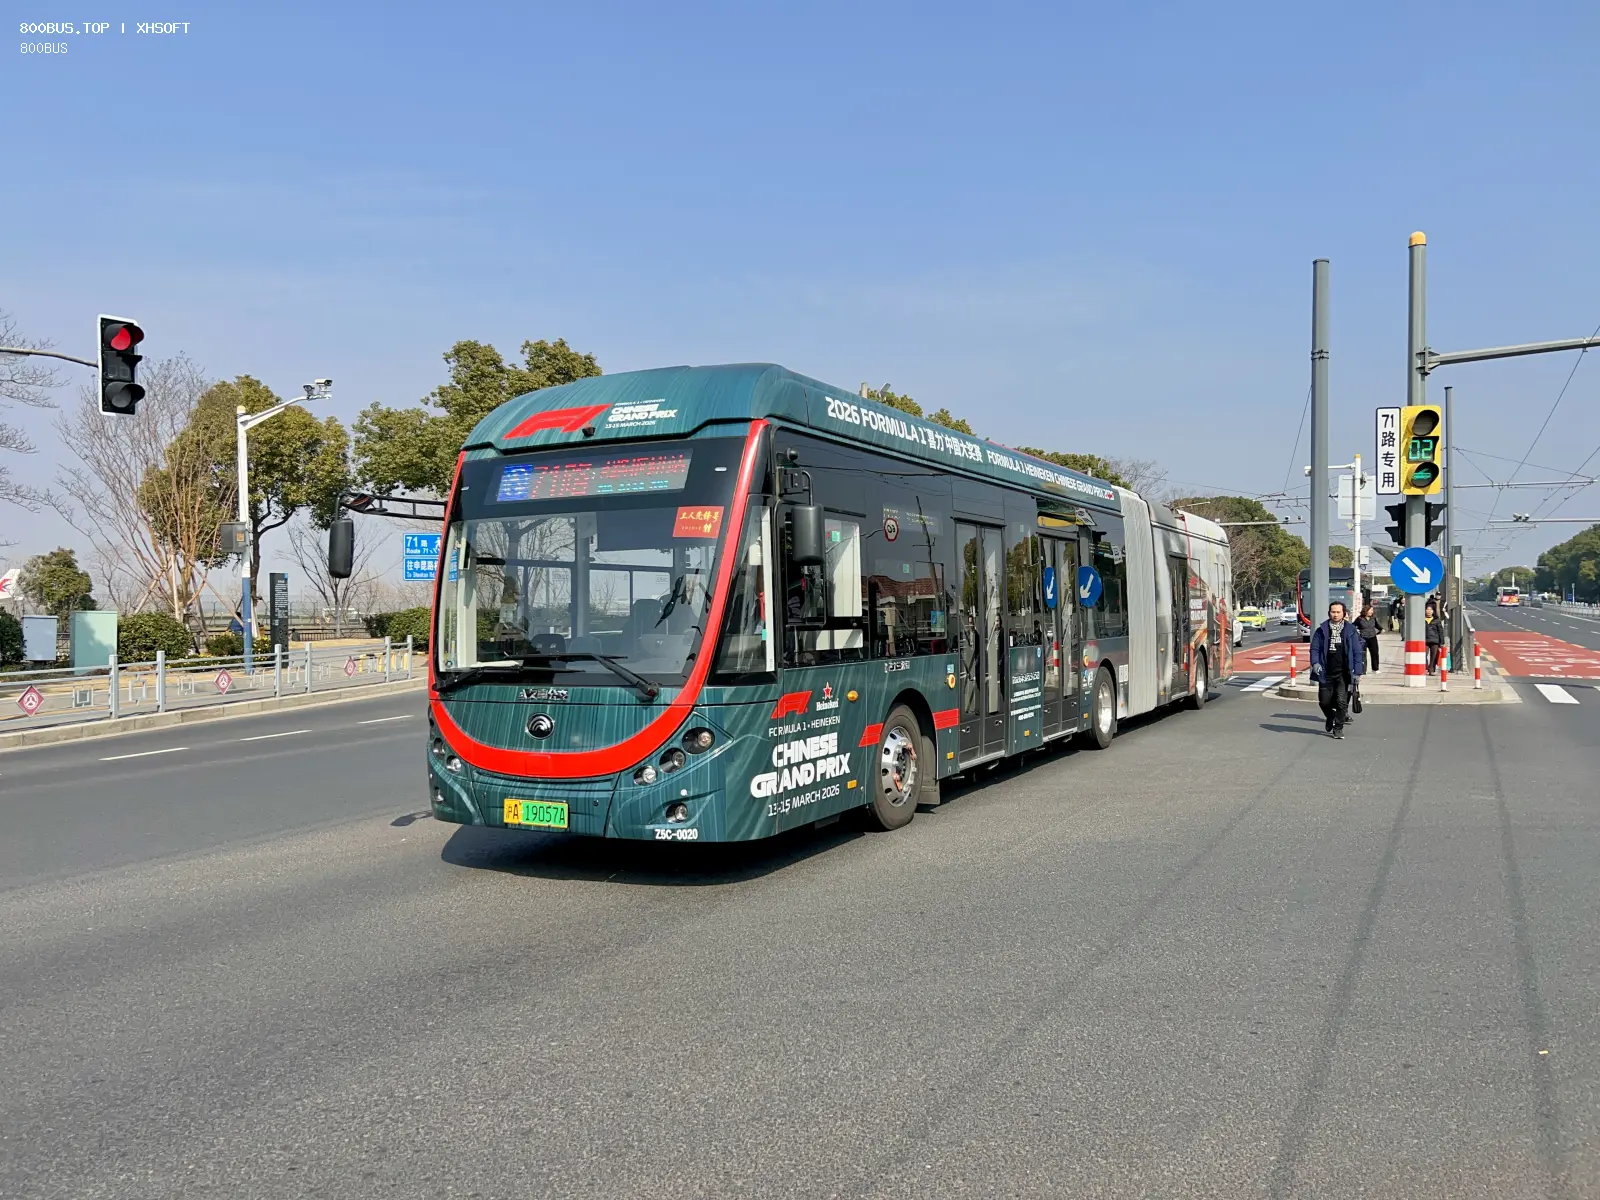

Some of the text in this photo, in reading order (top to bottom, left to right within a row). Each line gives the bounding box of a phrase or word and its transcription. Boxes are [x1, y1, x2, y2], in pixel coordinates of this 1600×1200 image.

[608, 409, 678, 422] GRAND PRIX
[825, 395, 860, 425] 2026
[860, 407, 919, 443] FORMULA
[918, 426, 927, 445] 1
[1380, 414, 1396, 487] 71路专用
[1408, 439, 1434, 461] 02
[986, 450, 1021, 473] FORMULA
[1025, 461, 1055, 483] HEINEKEN
[1054, 472, 1078, 490] CHINESE
[816, 699, 839, 712] Heineken
[768, 715, 841, 737] FORMULA 1 HEINEKEN
[772, 732, 838, 768] CHINESE
[750, 752, 851, 799] GRAND PRIX
[525, 804, 566, 825] 19057A
[768, 783, 840, 817] 13-15 MARCH 2026
